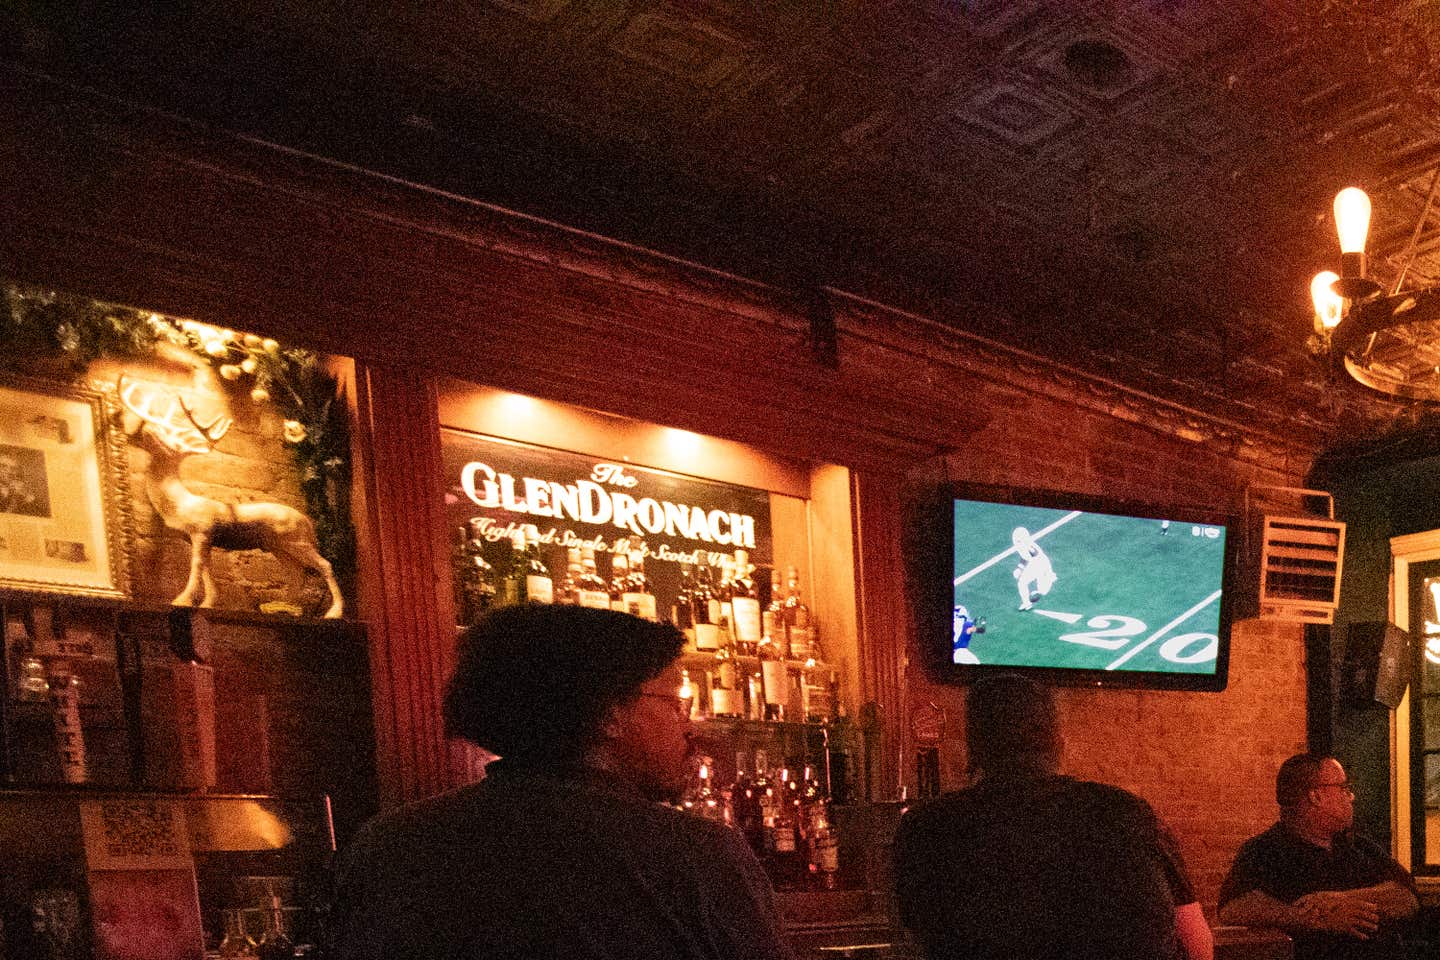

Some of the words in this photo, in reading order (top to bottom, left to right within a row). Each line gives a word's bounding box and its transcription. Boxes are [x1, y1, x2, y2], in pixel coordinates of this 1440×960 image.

[590, 463, 639, 488] The
[555, 529, 608, 554] Single
[650, 543, 700, 565] Scotch
